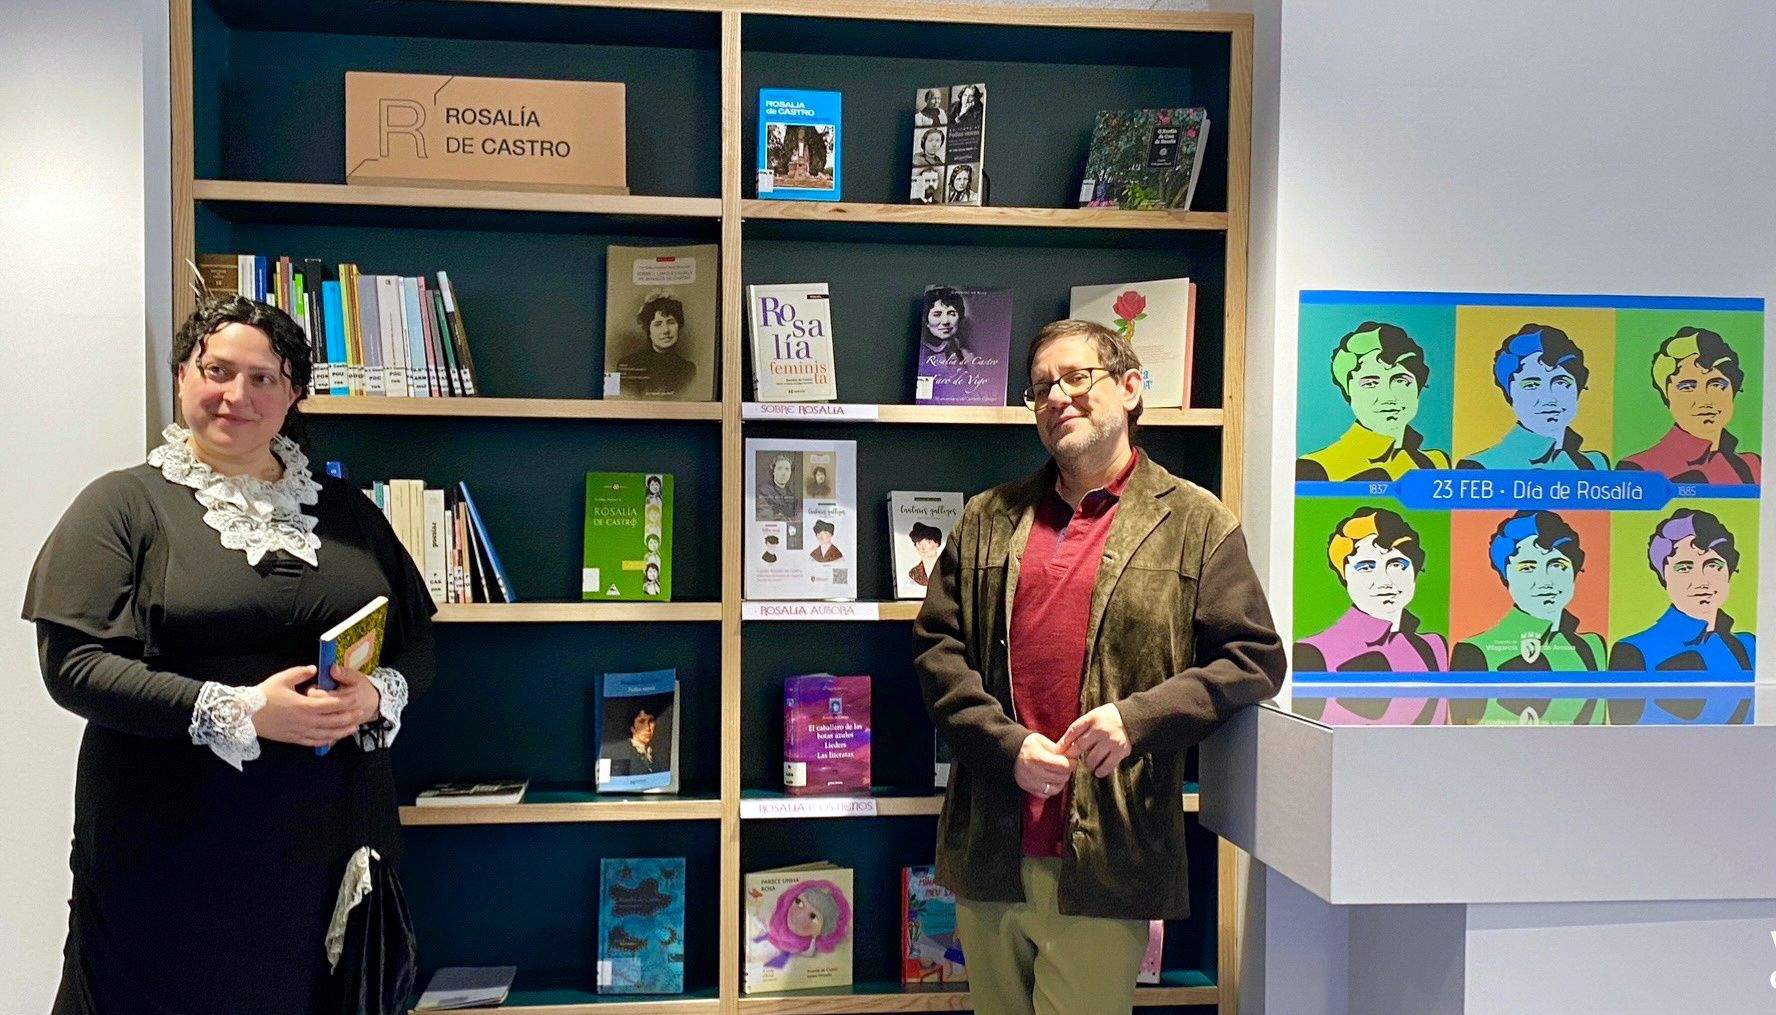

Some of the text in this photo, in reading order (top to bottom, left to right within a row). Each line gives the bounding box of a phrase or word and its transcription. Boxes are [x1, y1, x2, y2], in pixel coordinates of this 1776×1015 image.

[445, 106, 540, 127] ROSALÍA
[778, 108, 815, 117] CASTRO
[446, 137, 571, 158] DE CASTRO
[760, 405, 796, 415] SOBRE
[1368, 484, 1388, 495] 1837
[1432, 480, 1643, 500] 23 FEB Día de Rosalía
[593, 518, 638, 528] DE CASTRO
